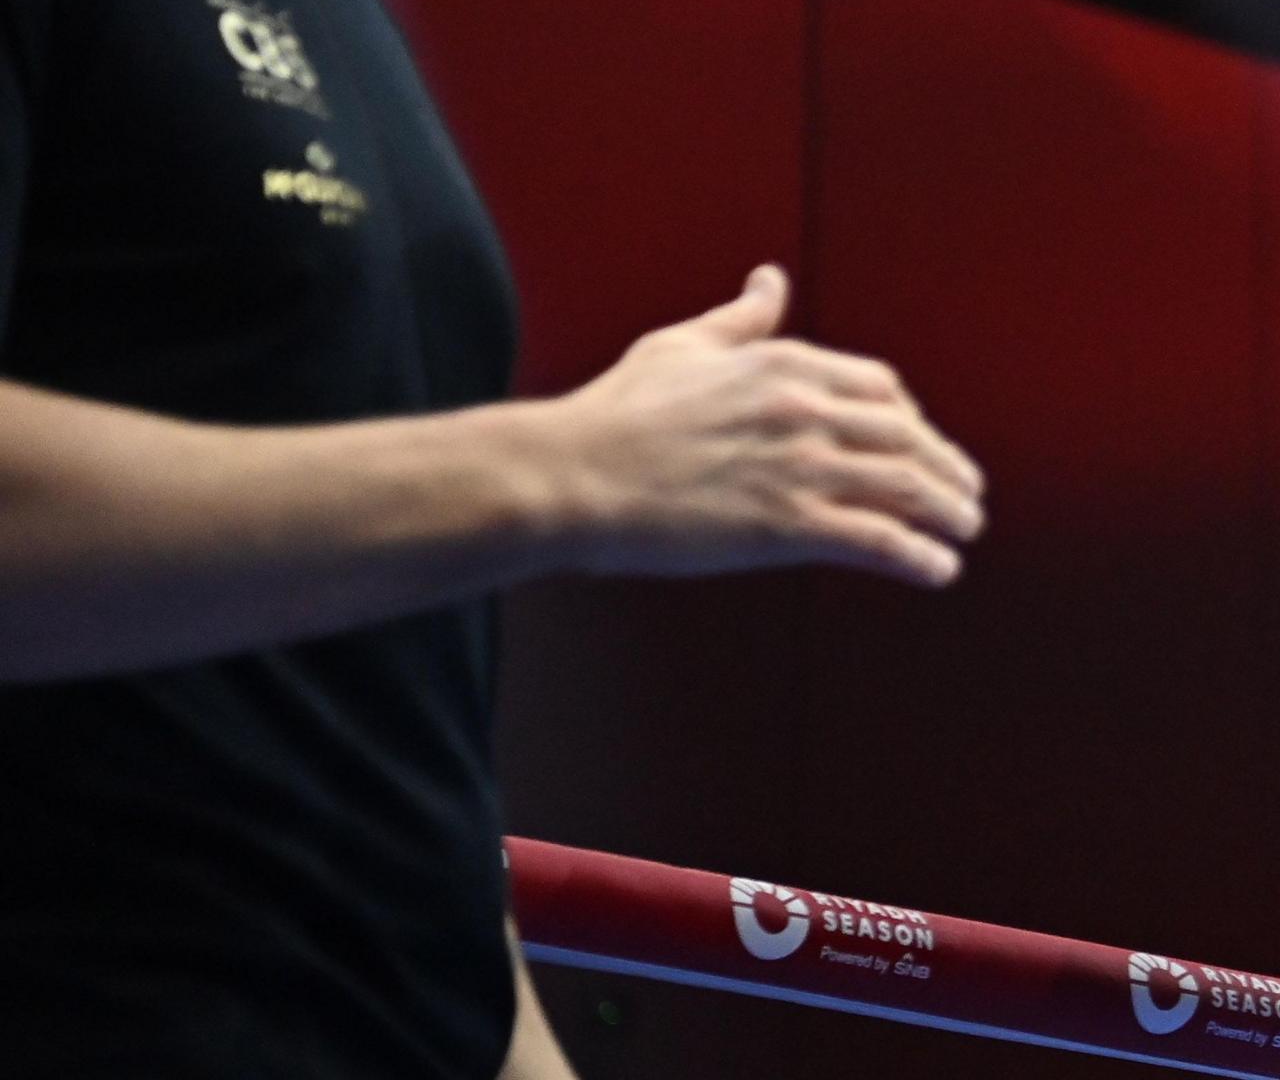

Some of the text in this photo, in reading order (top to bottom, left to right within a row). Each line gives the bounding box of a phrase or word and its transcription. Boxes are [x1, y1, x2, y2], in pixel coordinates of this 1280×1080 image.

[809, 891, 928, 925] RIYADH
[822, 910, 935, 951] SEASON
[820, 946, 873, 969] Powered
[874, 956, 890, 974] by
[1206, 1020, 1252, 1042] Powered
[1254, 1032, 1269, 1047] by
